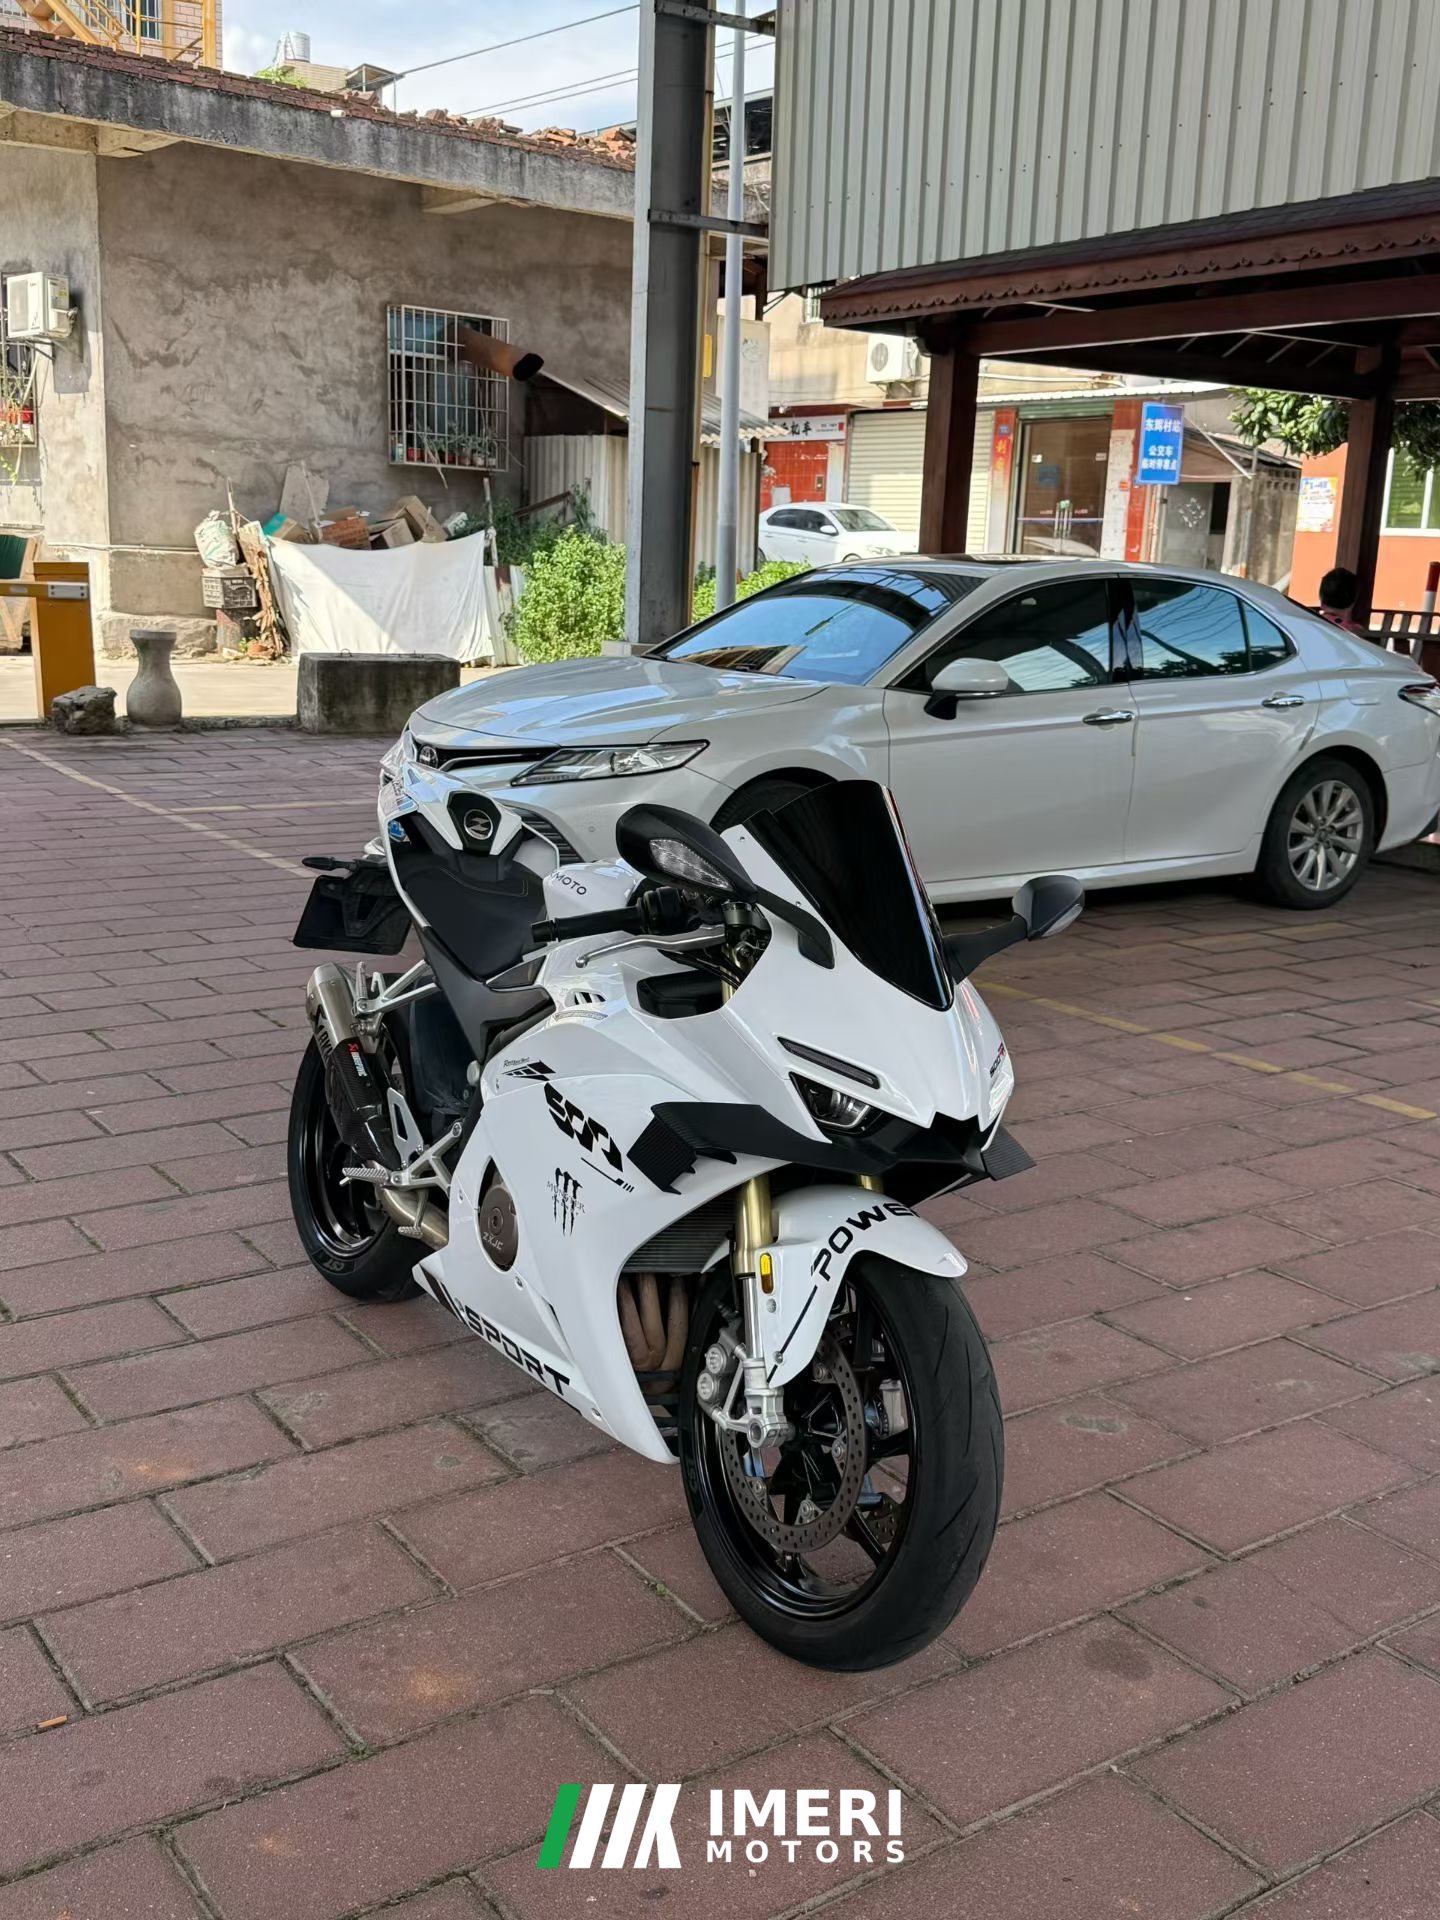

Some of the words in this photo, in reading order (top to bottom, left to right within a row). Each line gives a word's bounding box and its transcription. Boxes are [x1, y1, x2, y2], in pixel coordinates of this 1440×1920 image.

[551, 871, 587, 895] MOTO
[811, 1202, 921, 1282] POWE
[464, 1305, 571, 1396] SPORT
